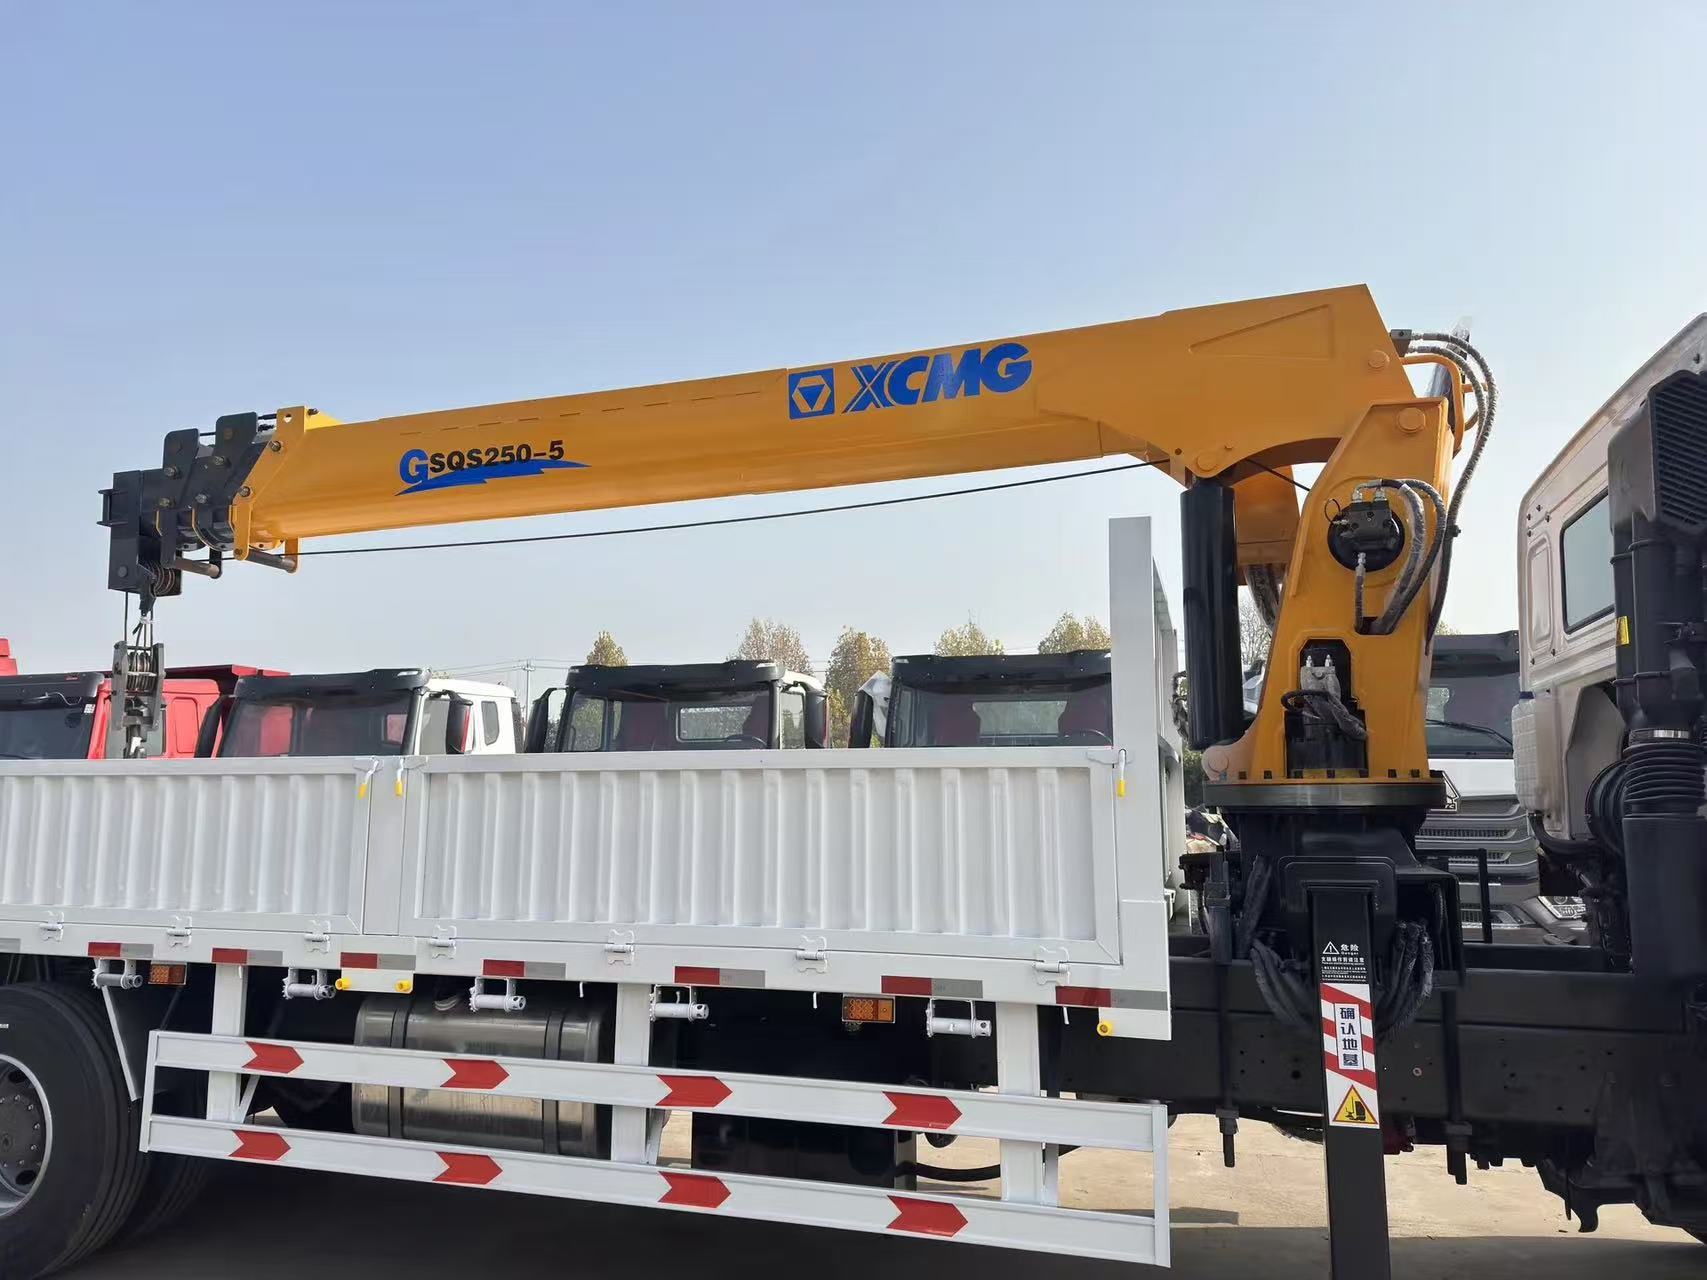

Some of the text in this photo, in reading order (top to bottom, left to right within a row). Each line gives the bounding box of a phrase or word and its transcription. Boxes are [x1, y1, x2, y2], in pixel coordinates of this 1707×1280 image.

[841, 342, 1033, 415] XCMG
[1340, 943, 1359, 952] 危险
[1339, 1007, 1359, 1067] 确认地基
